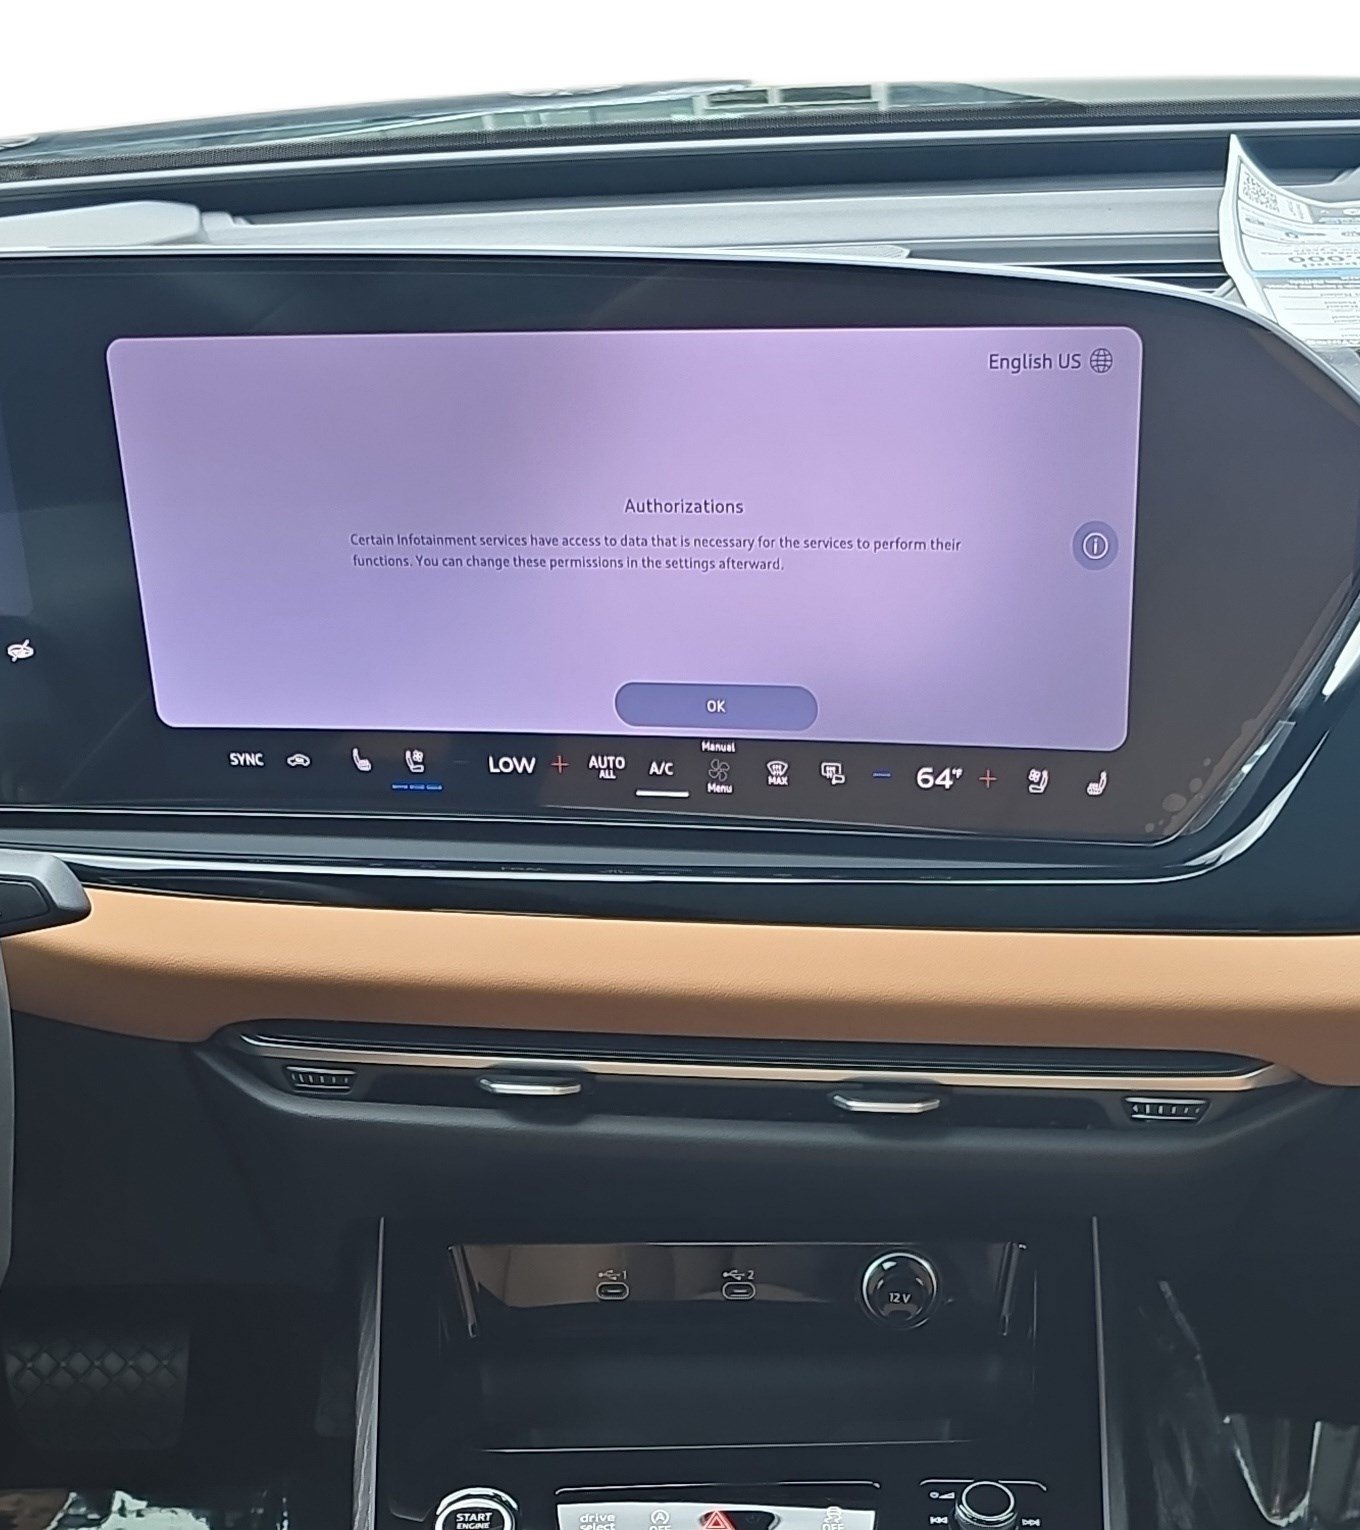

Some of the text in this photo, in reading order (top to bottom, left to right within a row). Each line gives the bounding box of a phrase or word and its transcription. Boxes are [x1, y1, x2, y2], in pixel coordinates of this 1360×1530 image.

[989, 353, 1082, 374] English US
[624, 498, 744, 514] Authorizations
[351, 534, 962, 553] Certain Infotainment services have access to data that is necessary for the services to perform their
[353, 555, 786, 572] functions. You can change these permissions in the settings afterward.
[706, 699, 727, 714] OK
[701, 740, 736, 753] Manual
[229, 752, 265, 767] SYNC
[488, 755, 537, 774] LOW
[588, 755, 626, 770] AUTO
[598, 768, 616, 780] ALL
[649, 760, 674, 776] A/C
[768, 774, 788, 786] MAX
[706, 782, 733, 794] Menu
[748, 1270, 755, 1280] 2
[456, 1512, 492, 1522] START
[580, 1513, 616, 1523] drive
[456, 1522, 491, 1530] ENGINE
